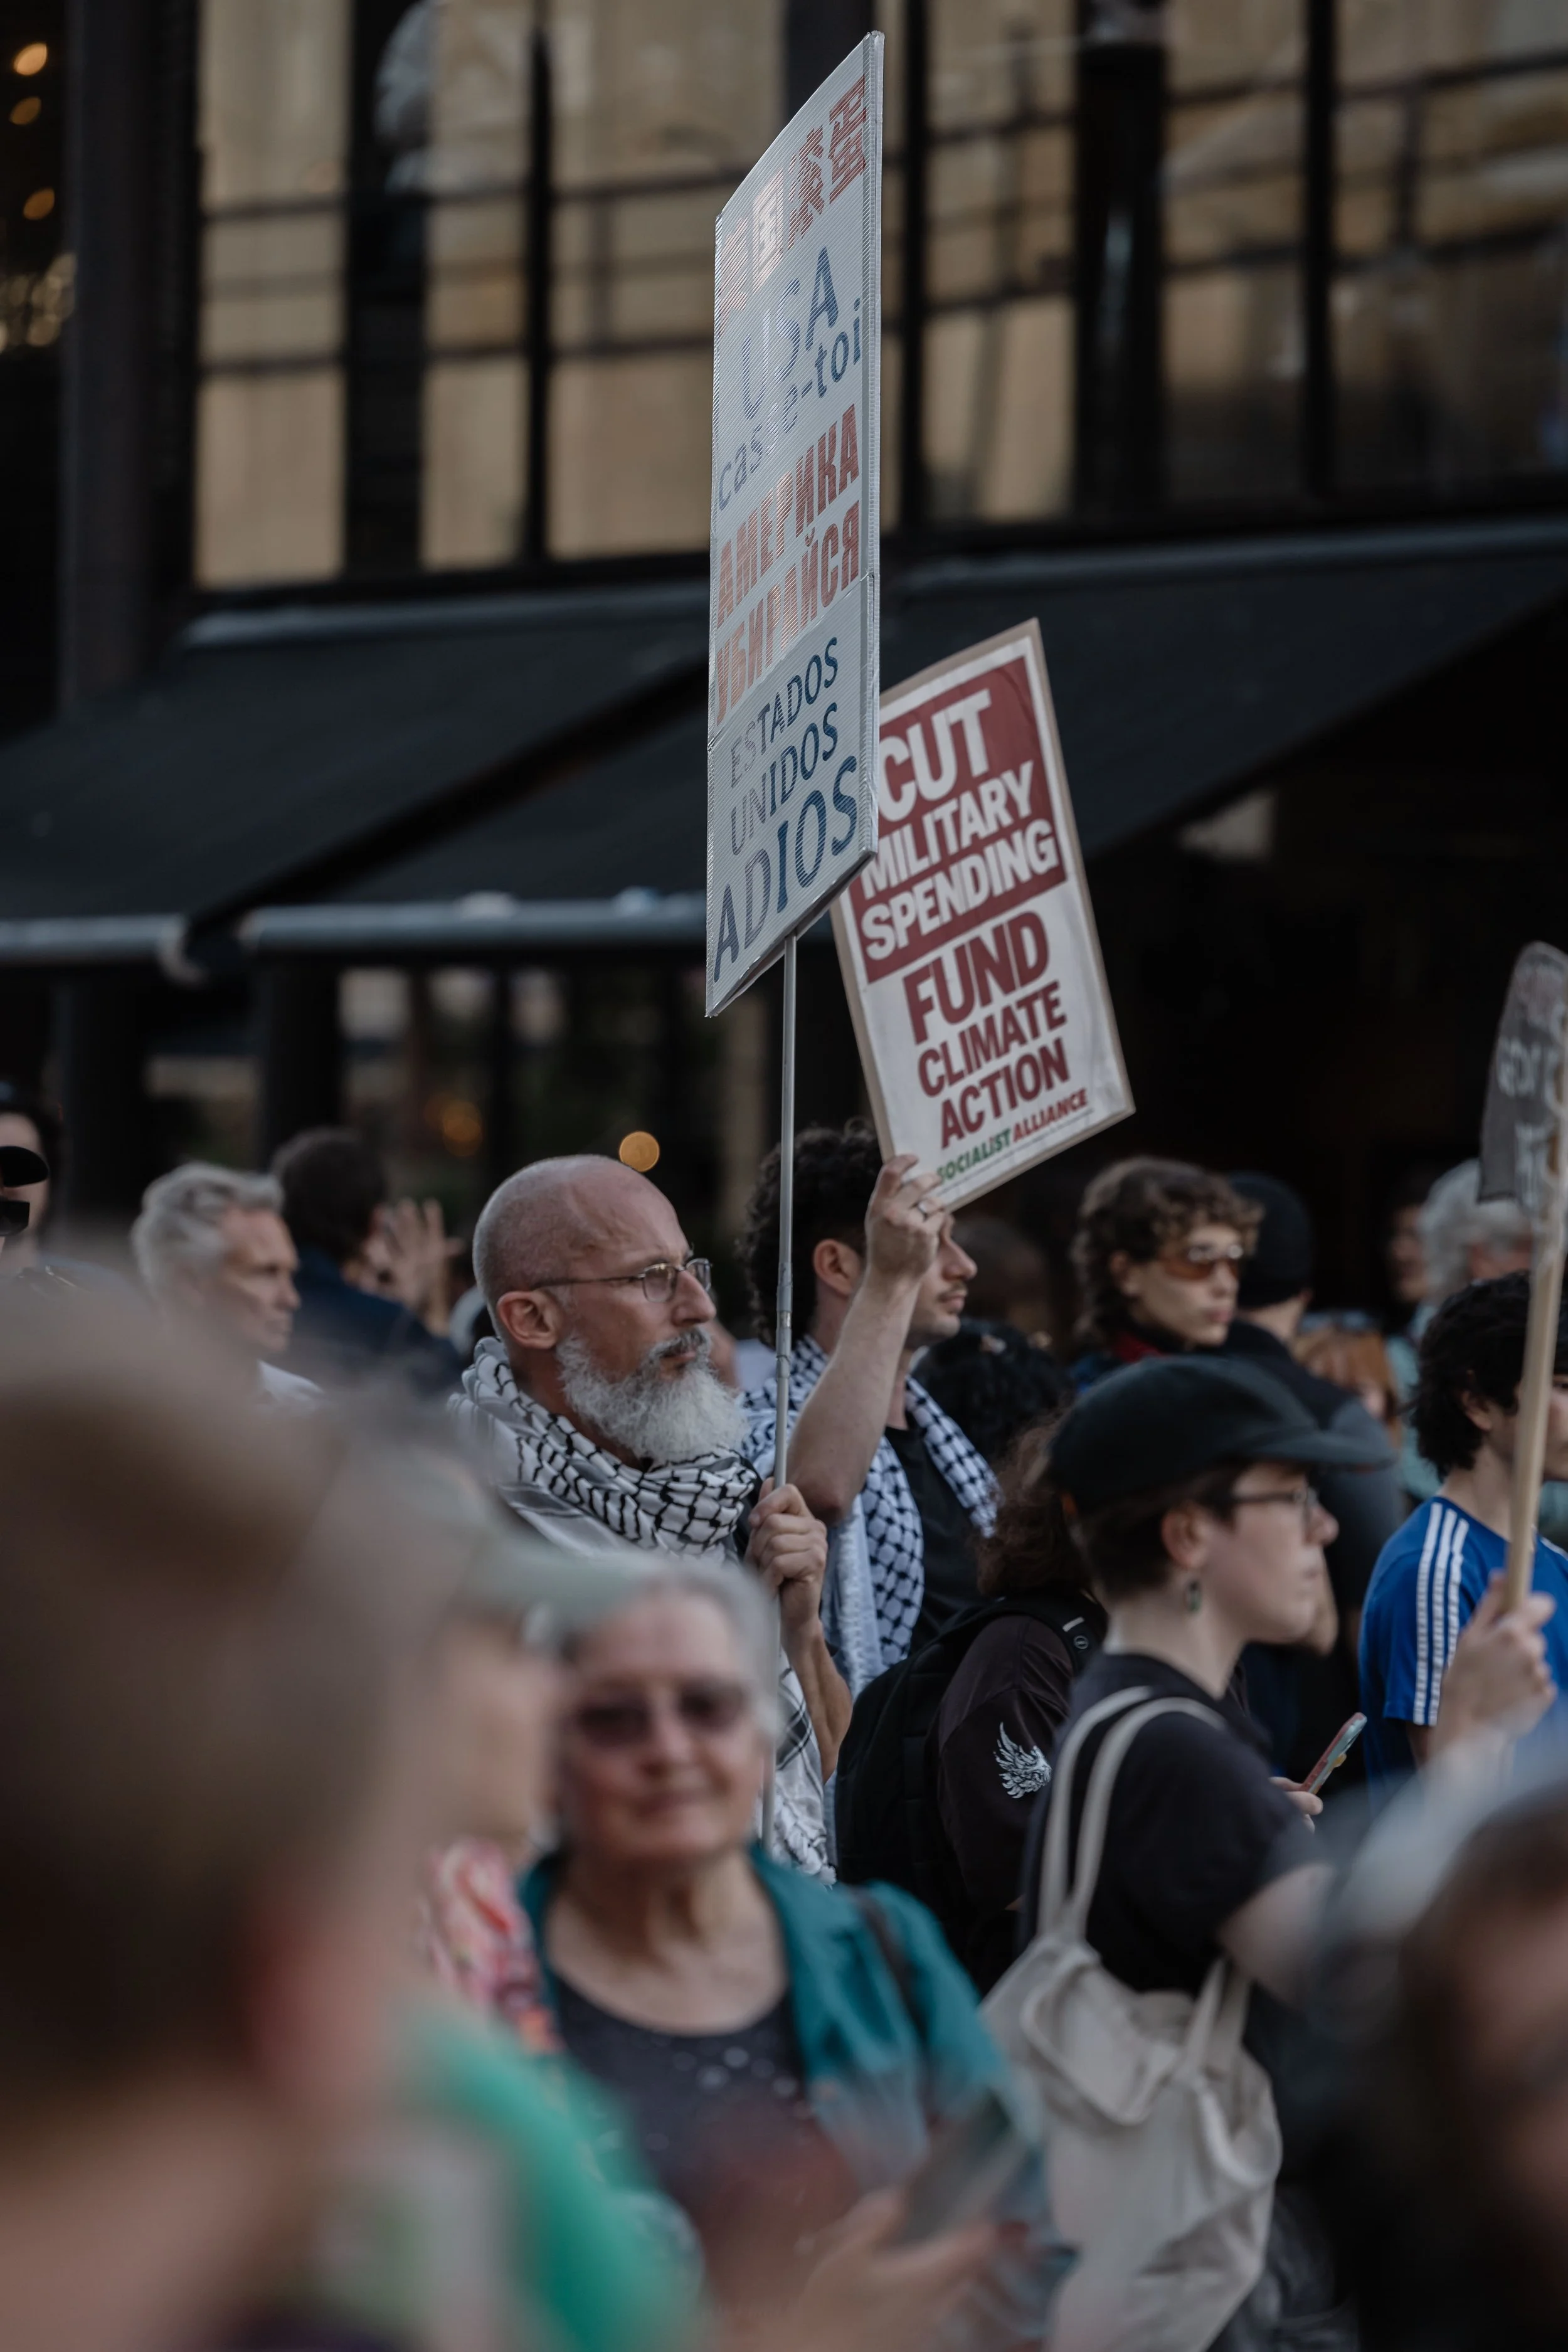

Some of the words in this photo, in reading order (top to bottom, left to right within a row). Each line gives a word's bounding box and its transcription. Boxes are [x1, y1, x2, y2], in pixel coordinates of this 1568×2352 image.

[718, 297, 861, 511] casse-toi
[742, 246, 839, 420] USA
[718, 403, 859, 629] АМЕРИКА
[716, 500, 859, 724] УБИРАЙСЯ
[731, 637, 838, 787] ESTADOS
[731, 702, 838, 855] UNIDOS
[878, 688, 992, 822] CUT
[714, 756, 857, 983] ADIOS
[861, 760, 1034, 900] MILITARY
[861, 818, 1059, 960] SPENDING
[903, 910, 1049, 1046] FUND
[918, 980, 1067, 1098] CLIMATE
[941, 1037, 1070, 1149] ACTION
[1012, 1088, 1088, 1143] ALLIANCE
